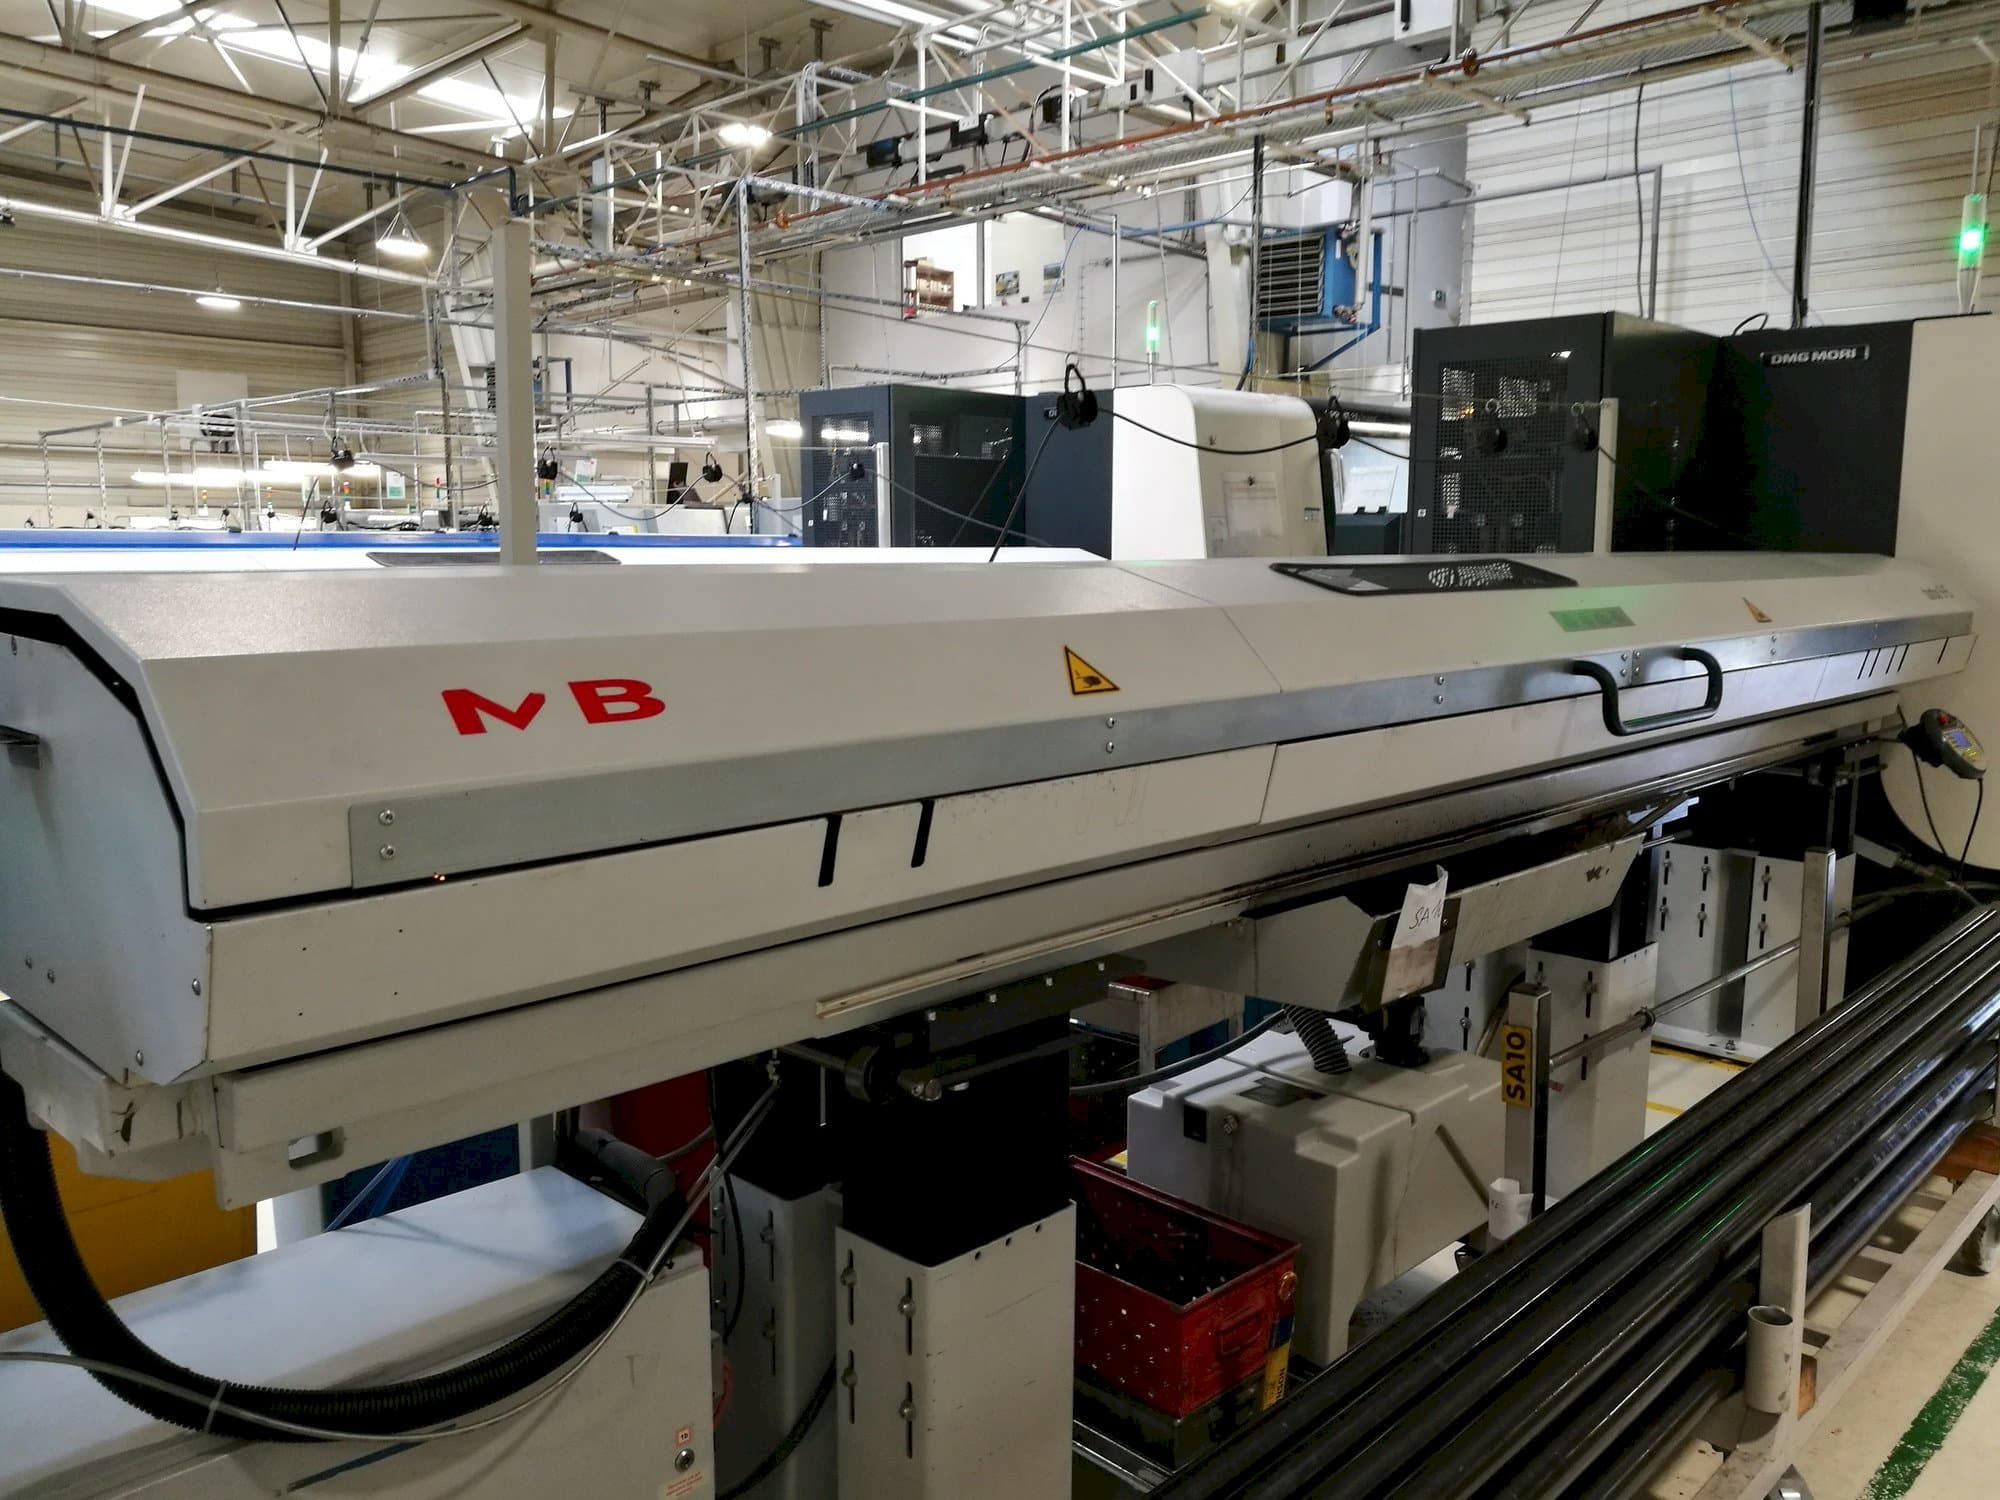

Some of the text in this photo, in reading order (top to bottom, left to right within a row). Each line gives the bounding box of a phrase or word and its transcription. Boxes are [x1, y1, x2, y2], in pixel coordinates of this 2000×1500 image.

[1770, 347, 1857, 365] DMG MORI
[1506, 1031, 1526, 1101] SA10
